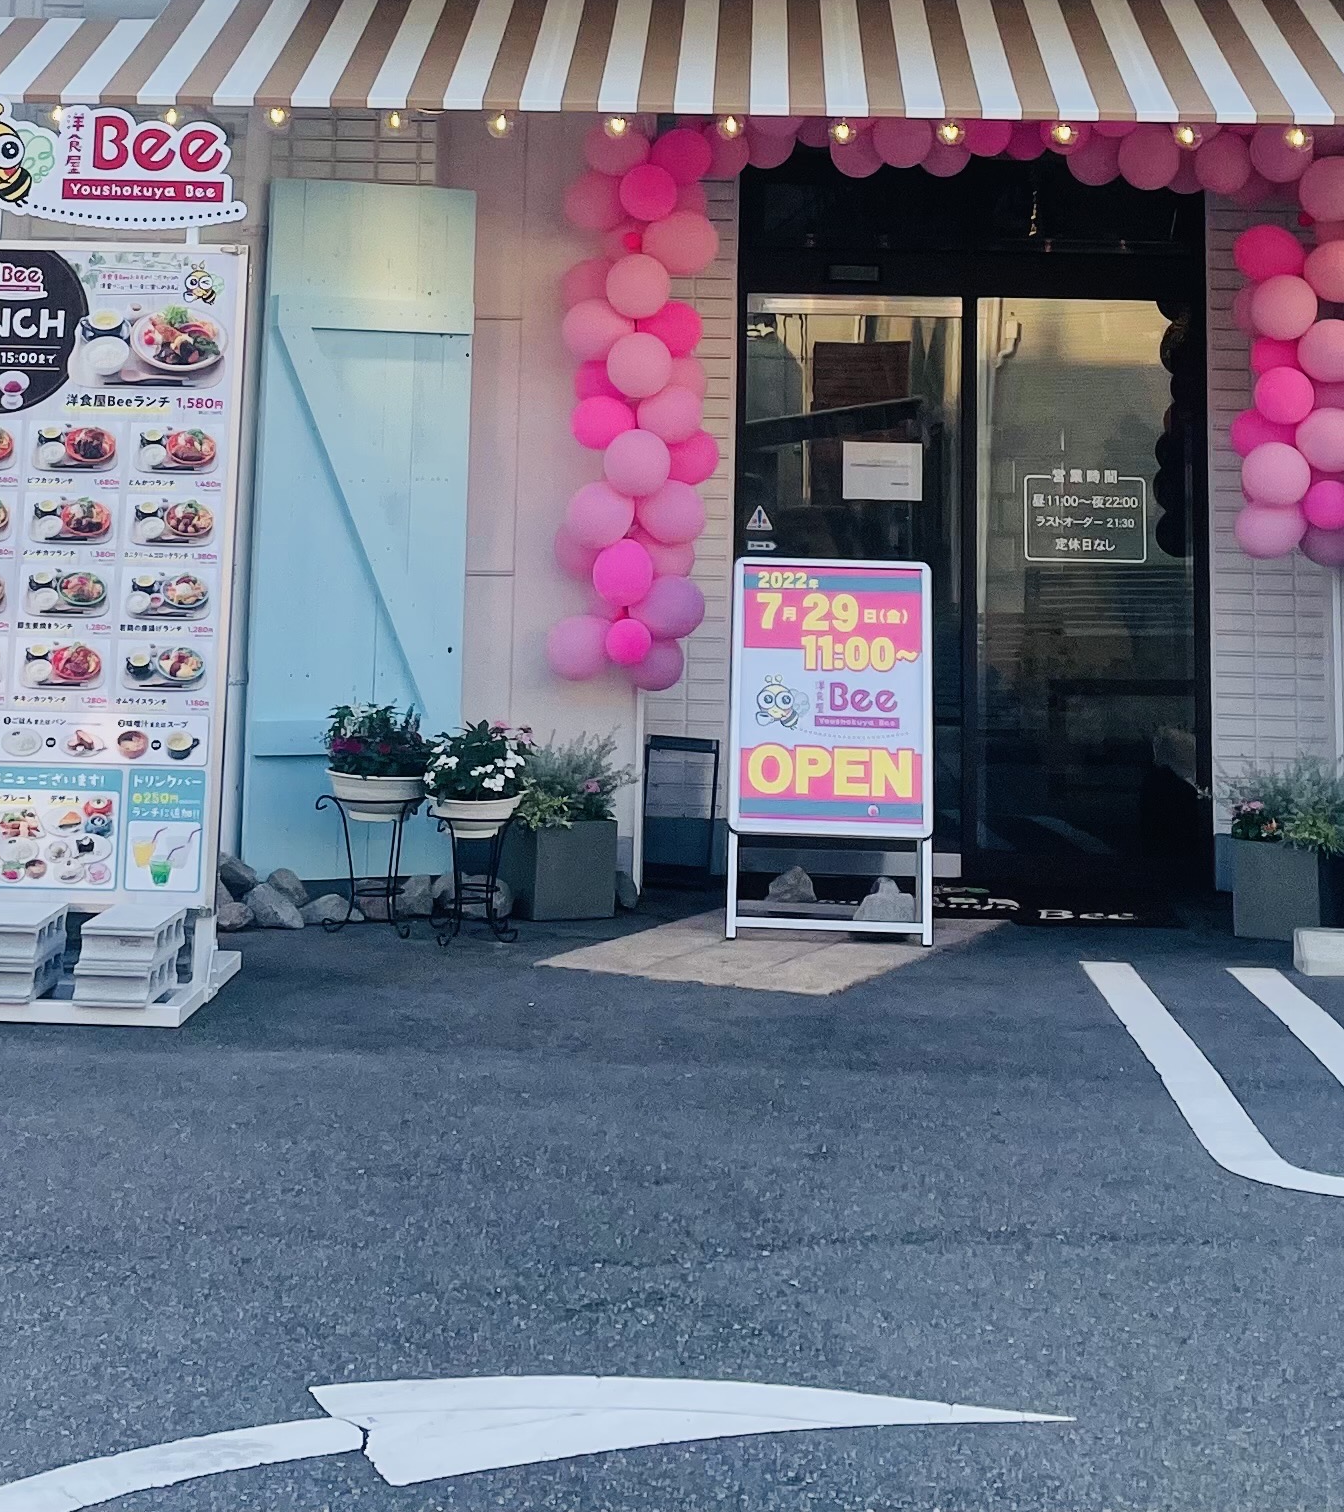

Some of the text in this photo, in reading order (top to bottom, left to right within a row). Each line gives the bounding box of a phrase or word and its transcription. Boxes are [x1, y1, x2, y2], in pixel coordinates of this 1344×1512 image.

[65, 112, 85, 175] 洋食屋
[92, 115, 223, 173] Bee
[70, 183, 216, 199] Youshokuya Bee
[2, 265, 41, 283] Bee
[66, 394, 224, 410] 洋食屋Beeランチ 1,580円
[1036, 515, 1135, 529] ラストオーダー 21:30
[1055, 538, 1116, 551] 定休日なし
[757, 571, 820, 591] 2022年
[829, 681, 899, 713] Bee
[747, 743, 913, 799] OPEN
[134, 774, 203, 788] ドリンクバー
